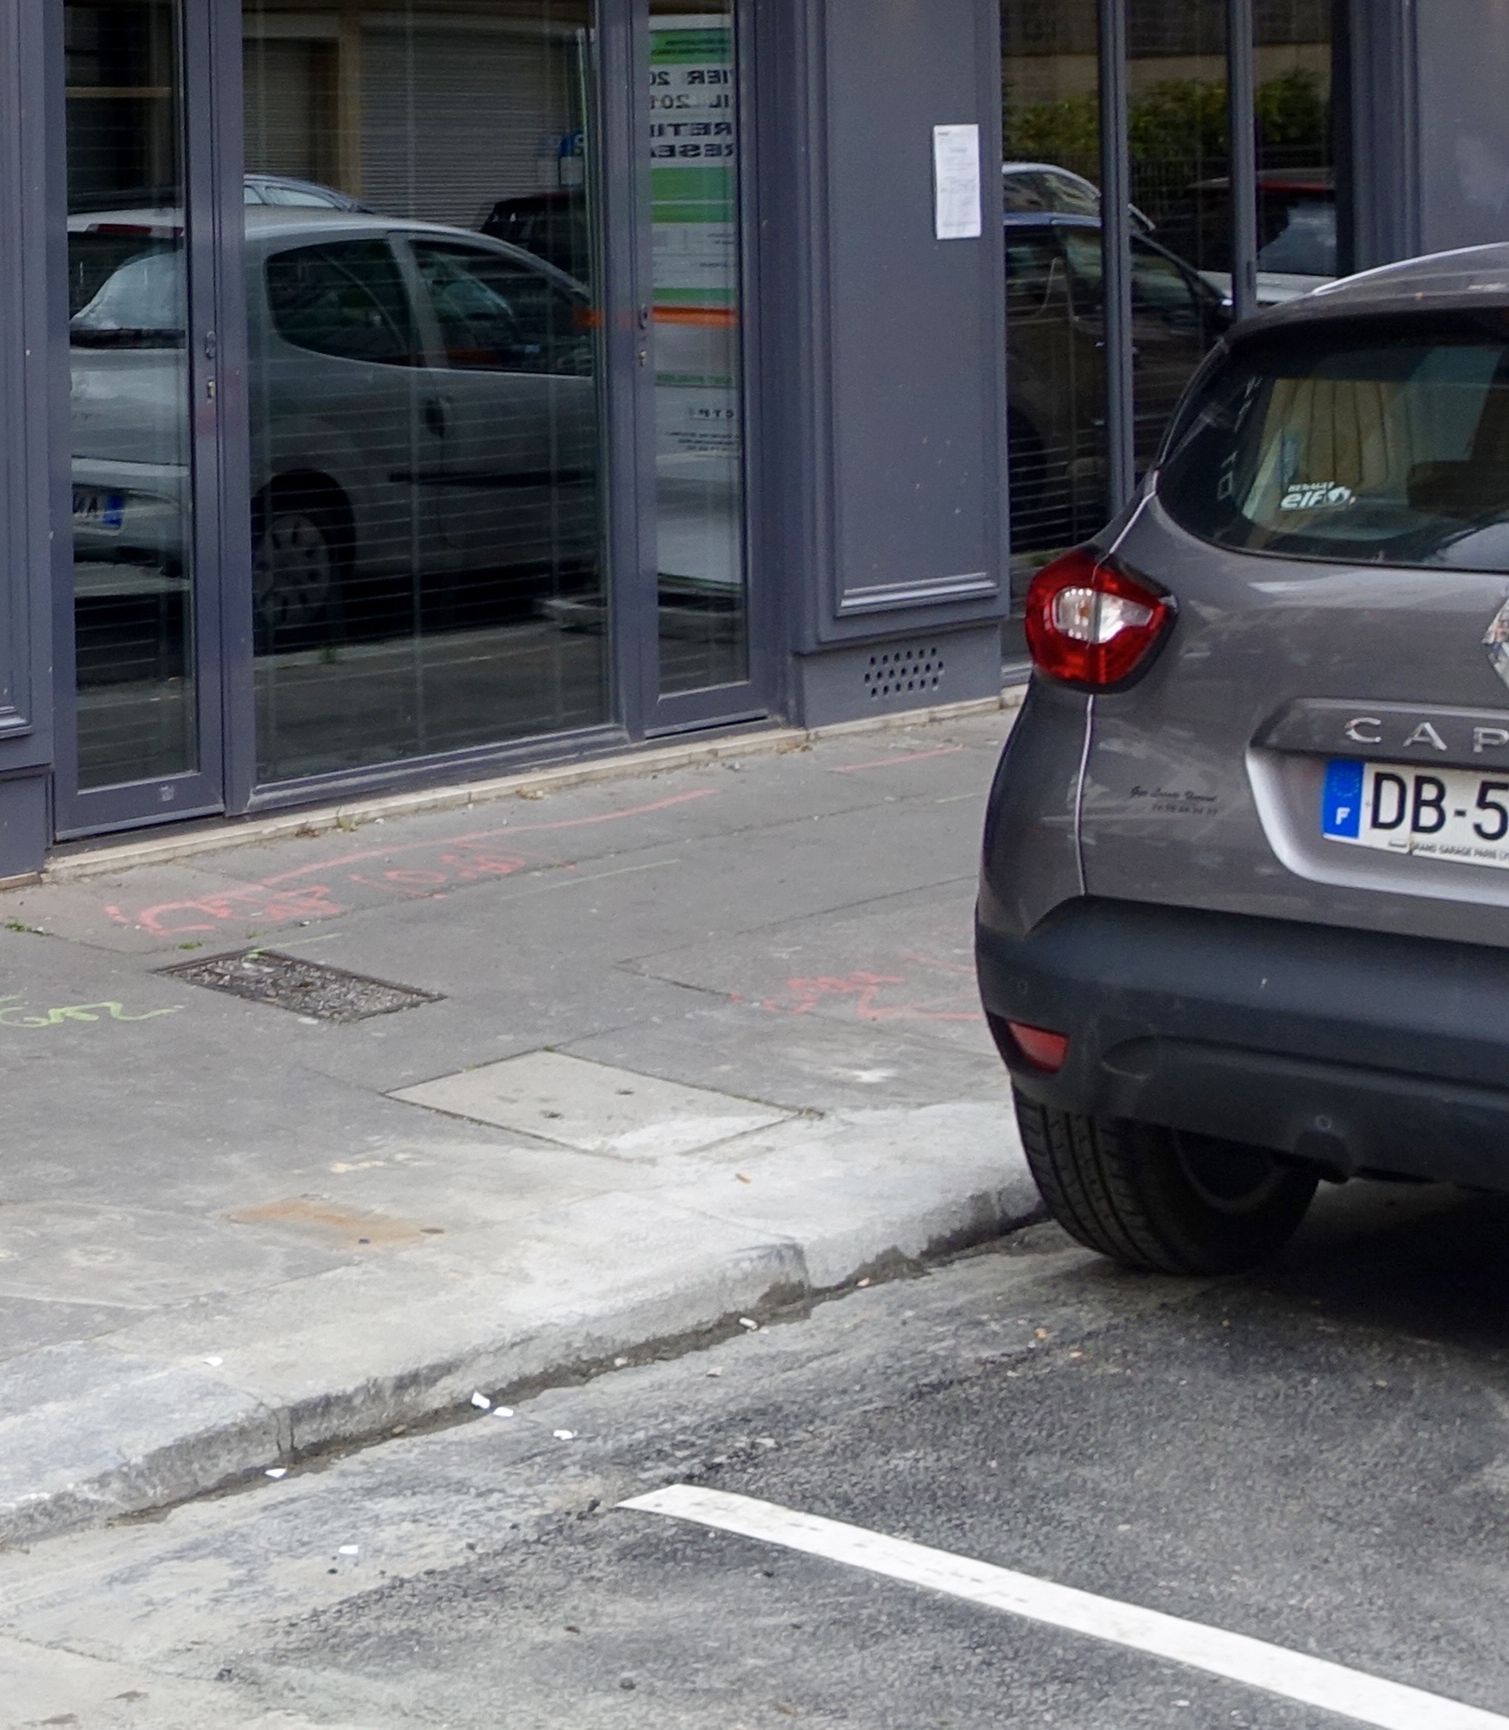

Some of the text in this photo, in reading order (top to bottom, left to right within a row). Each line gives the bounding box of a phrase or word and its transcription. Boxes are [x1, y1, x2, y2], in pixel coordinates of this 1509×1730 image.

[1281, 490, 1327, 509] elf
[1335, 807, 1351, 825] F
[1370, 772, 1509, 841] DB-5
